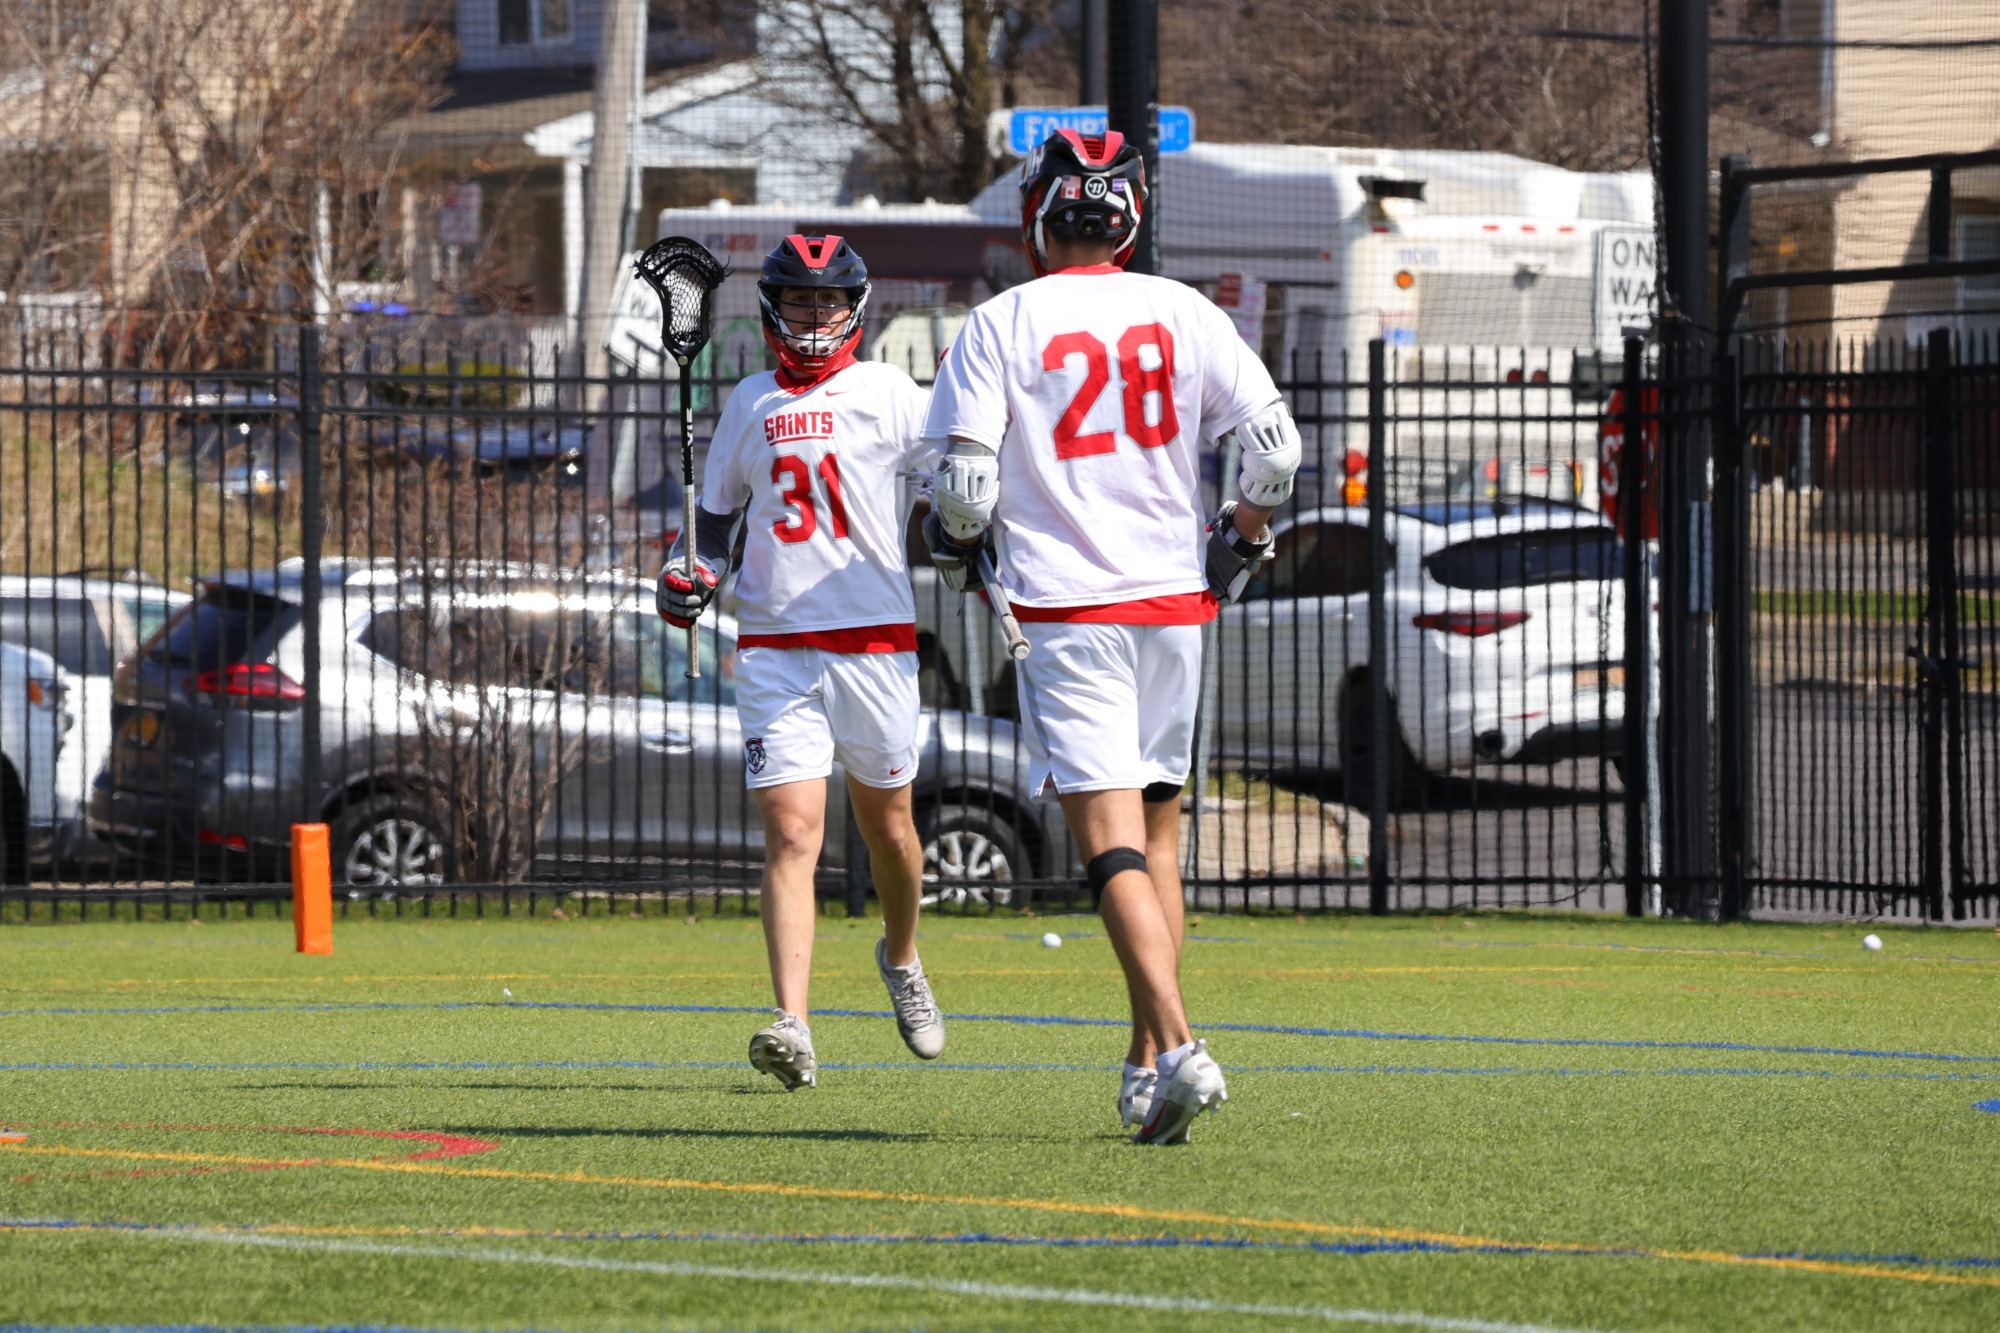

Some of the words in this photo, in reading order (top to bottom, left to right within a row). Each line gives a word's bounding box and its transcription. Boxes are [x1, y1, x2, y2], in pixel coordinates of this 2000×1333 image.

[1612, 238, 1654, 267] ON
[1610, 278, 1653, 306] WA
[1041, 321, 1181, 461] 28
[771, 453, 849, 543] 31
